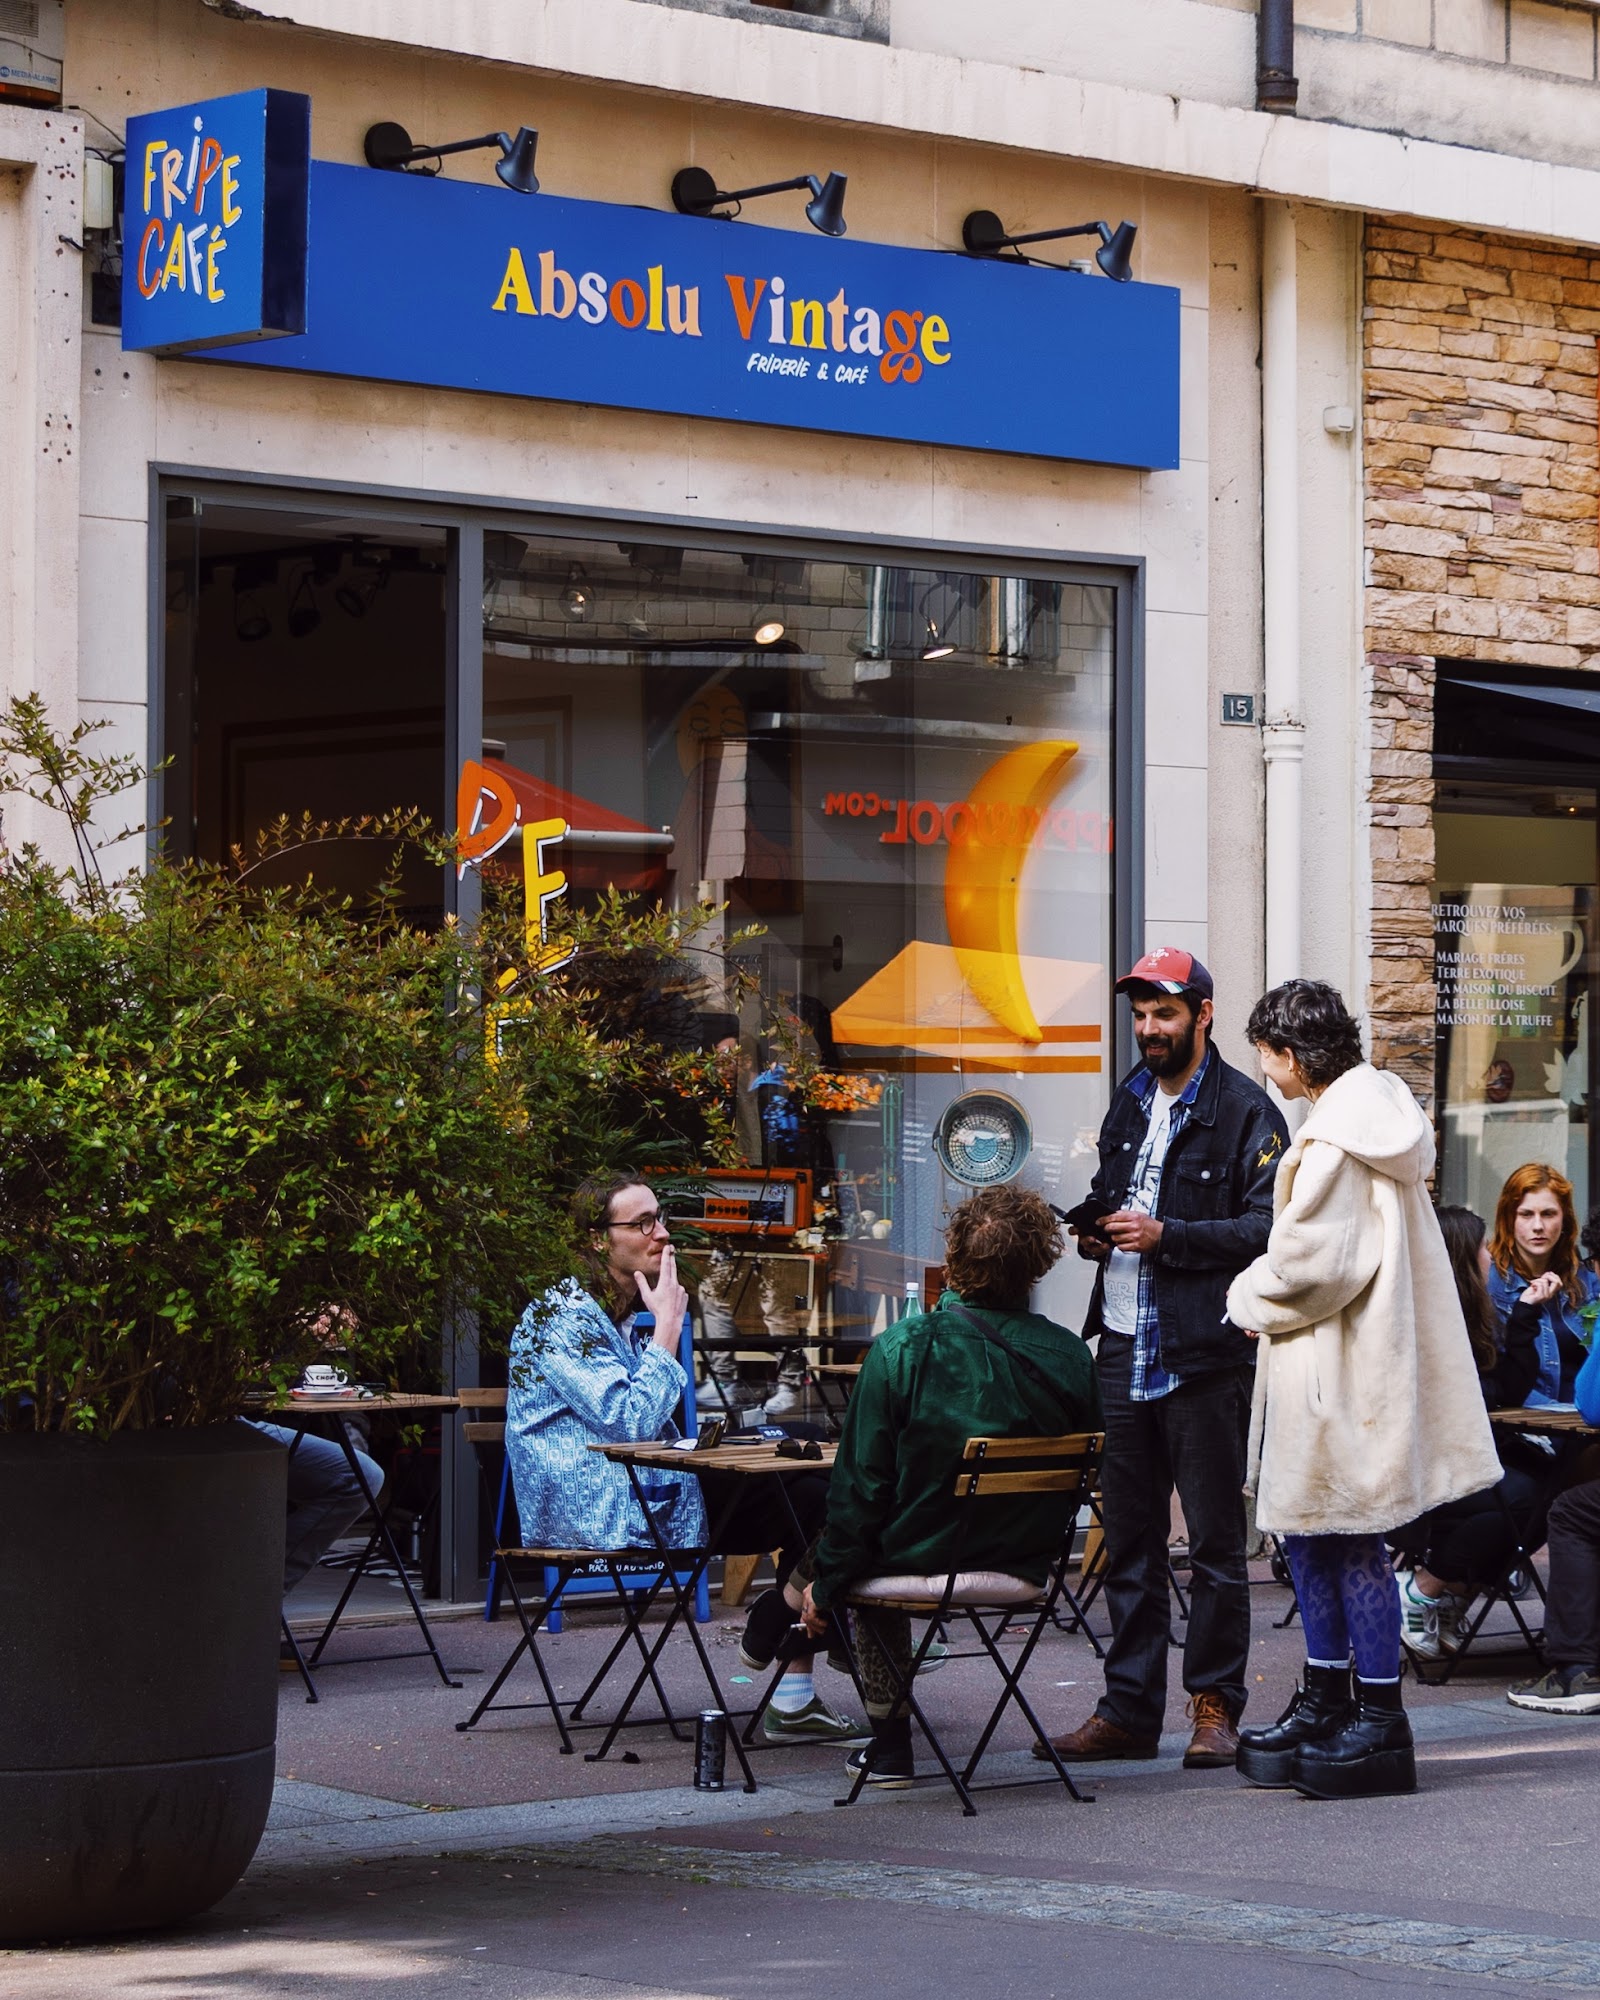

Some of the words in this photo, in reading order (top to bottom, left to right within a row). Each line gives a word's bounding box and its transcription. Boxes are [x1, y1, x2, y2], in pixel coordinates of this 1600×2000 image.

[137, 218, 227, 304] CAFÉ
[491, 247, 703, 338] Absolu
[725, 275, 952, 385] Vintage
[816, 362, 829, 381] &
[834, 364, 870, 386] CAFÉ
[1230, 699, 1248, 718] 15
[1431, 904, 1500, 919] RETROUVEZ
[1502, 905, 1526, 921] VOS
[1436, 951, 1485, 964] MARIAGE
[1436, 965, 1473, 980] TERRE
[1473, 967, 1526, 984] EXOTIQUE
[1436, 981, 1451, 994] LA
[1452, 983, 1496, 995] MAISON
[1497, 984, 1514, 996] DU
[1515, 984, 1557, 996] BISCUIT
[1436, 996, 1451, 1010] LA
[1452, 998, 1485, 1010] BELLE
[1486, 998, 1526, 1011] ILLOISE
[1436, 1012, 1481, 1025] MAISON
[1482, 1013, 1497, 1026] DE
[1499, 1014, 1513, 1026] LA
[1514, 1014, 1554, 1027] TRUFFE
